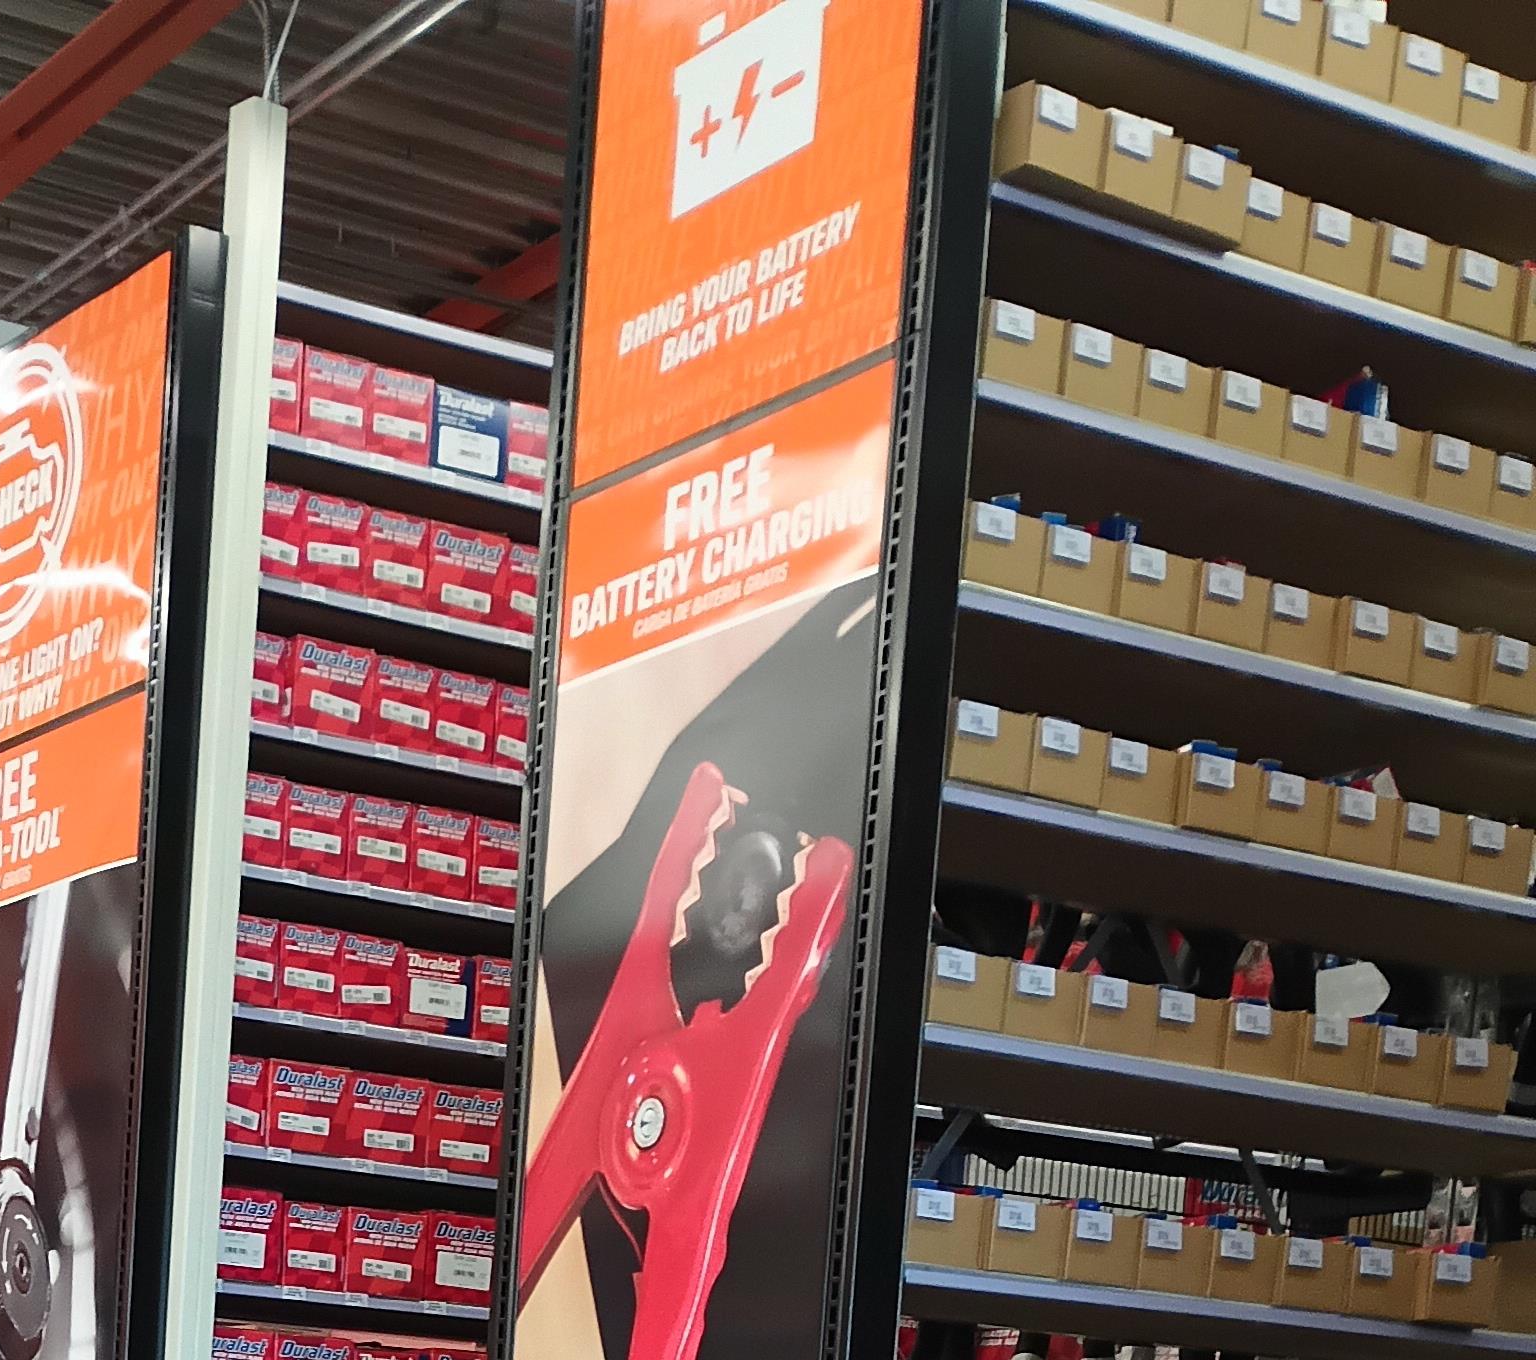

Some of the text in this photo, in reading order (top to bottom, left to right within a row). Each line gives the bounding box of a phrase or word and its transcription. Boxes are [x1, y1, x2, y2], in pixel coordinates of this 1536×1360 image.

[618, 202, 861, 356] BRING YOUR BATTERY
[660, 269, 806, 373] BACK TO LIFE
[664, 443, 775, 551] FREE
[435, 530, 503, 560] Duralast
[569, 480, 874, 639] BATTERY CHARGING
[22, 634, 68, 678] LIGHT
[69, 616, 104, 661] ON?
[302, 642, 370, 671] Duralast
[379, 659, 433, 684] Duralast
[439, 673, 494, 697] Duralast
[17, 674, 63, 721] WHY!
[290, 787, 346, 811] Duralast
[354, 797, 410, 820] Duralast
[416, 809, 472, 832] Duralast
[479, 822, 520, 840] Durala
[285, 924, 340, 947] Duralast
[344, 935, 399, 958] Duralast
[406, 953, 462, 973] Duralast
[275, 1066, 345, 1091] Duralast
[353, 1079, 425, 1103] Duralast
[434, 1091, 504, 1115] Duralast
[221, 1198, 277, 1217] uralast
[288, 1203, 342, 1225] Duralast
[353, 1214, 424, 1238] Duralast
[435, 1221, 496, 1243] Duralas
[212, 1335, 268, 1356] uralast
